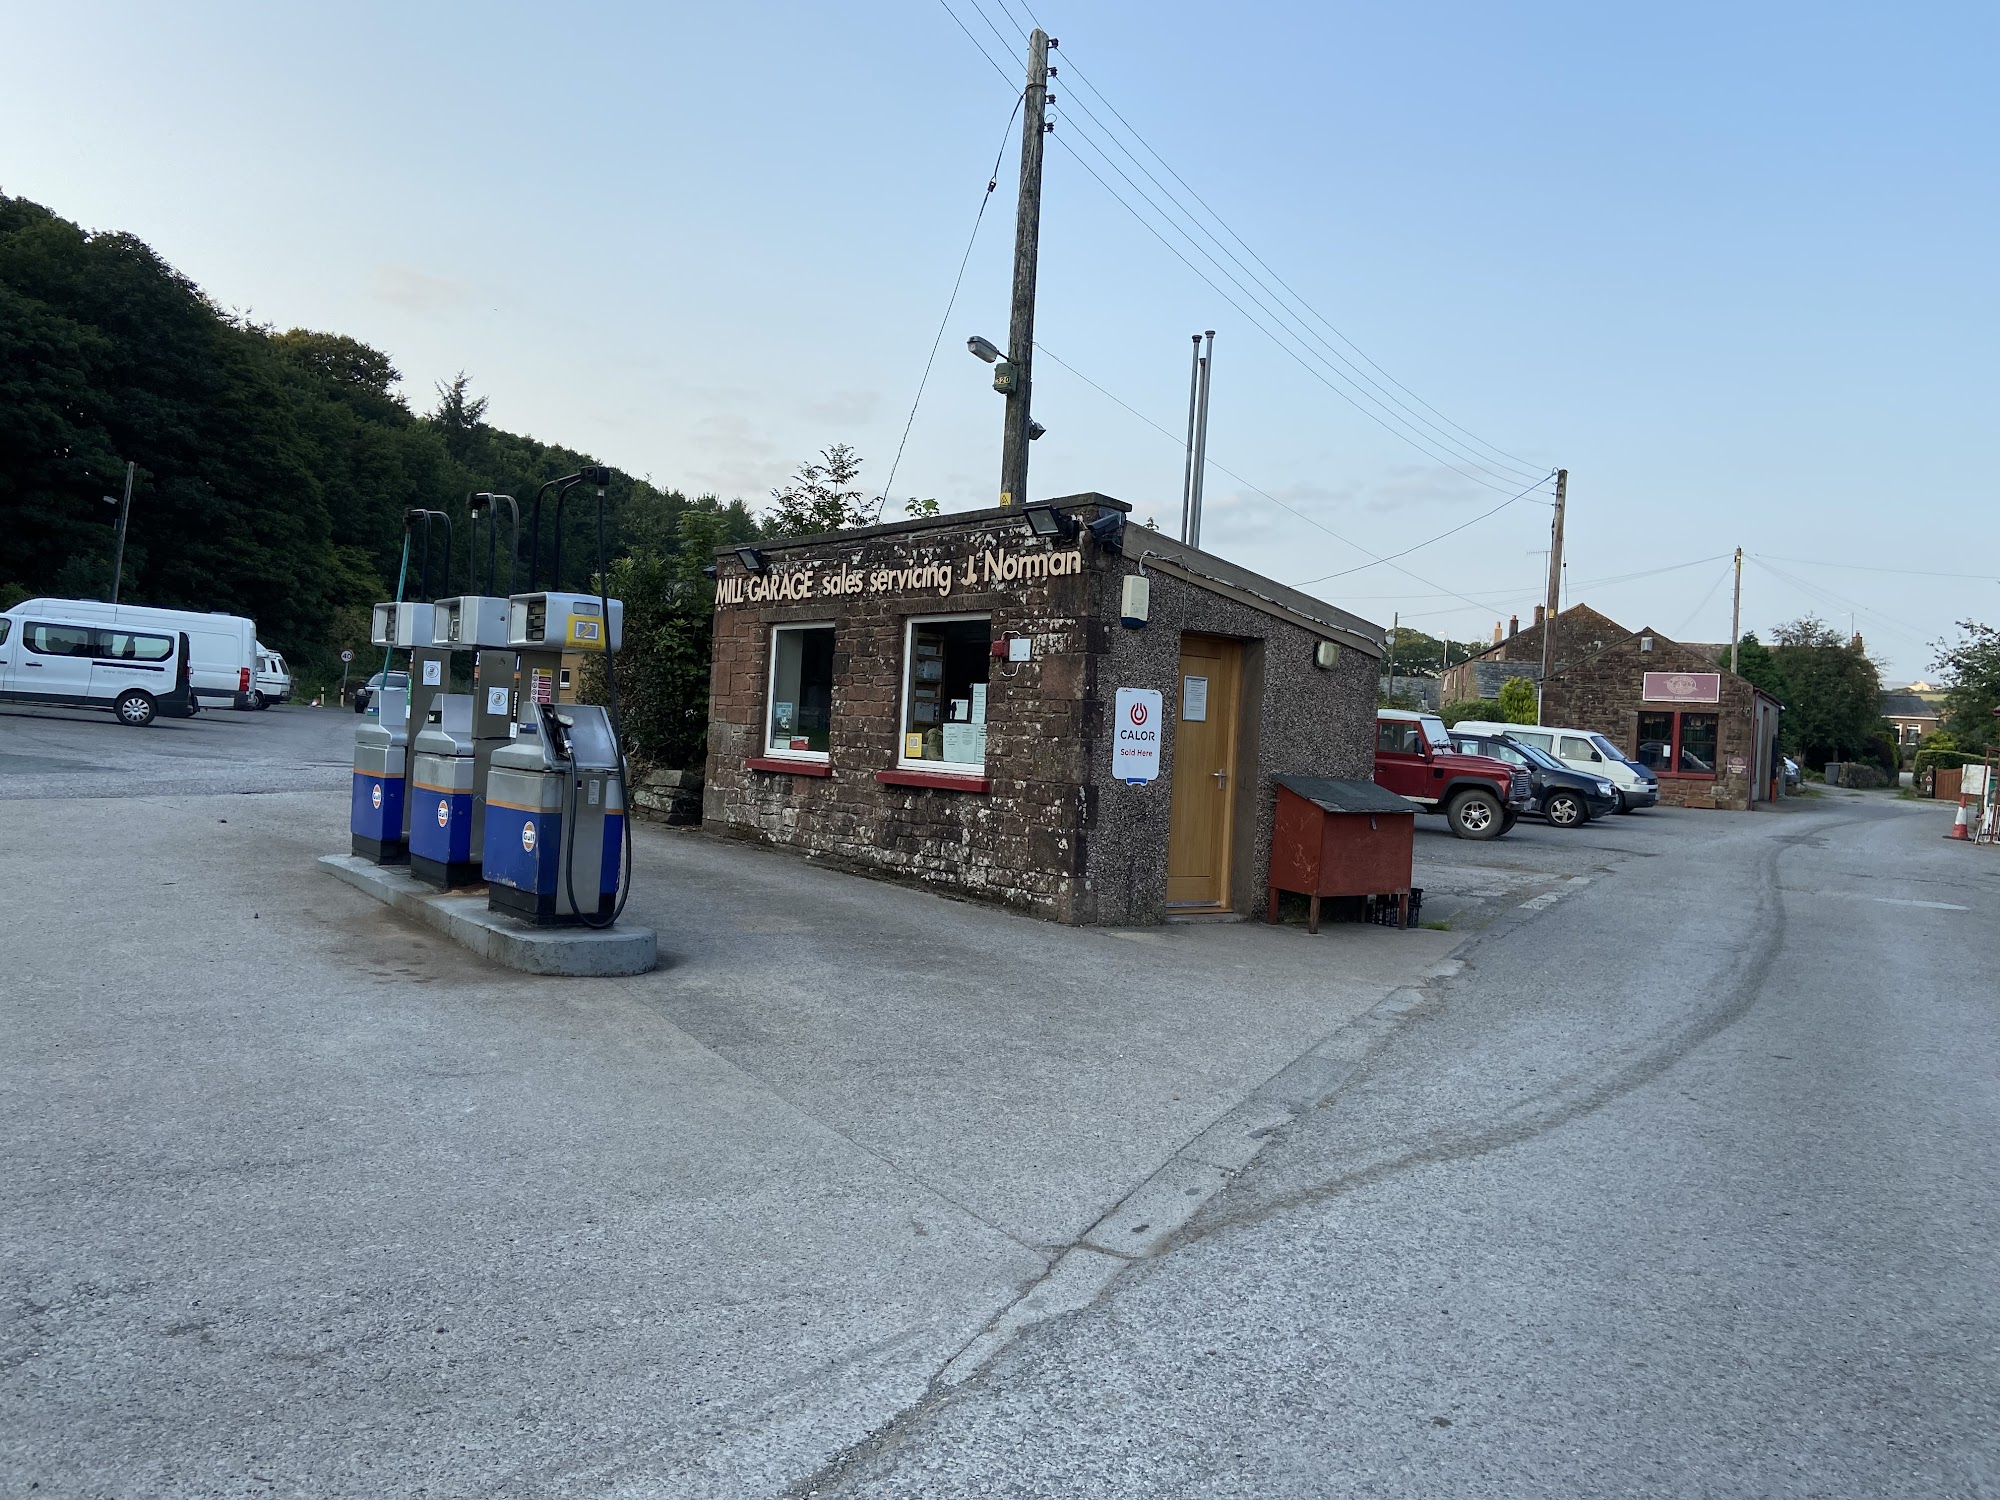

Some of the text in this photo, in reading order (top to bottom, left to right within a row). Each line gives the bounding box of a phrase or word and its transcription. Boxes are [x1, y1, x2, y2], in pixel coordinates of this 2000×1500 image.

[715, 548, 1081, 605] MILL GARAGE sales servicing J. Norman
[475, 652, 480, 666] 2
[516, 655, 521, 671] 1
[1120, 729, 1156, 742] CALOR
[1120, 748, 1153, 757] Sold Here
[438, 809, 448, 818] Gulf
[523, 831, 535, 841] Gulf
